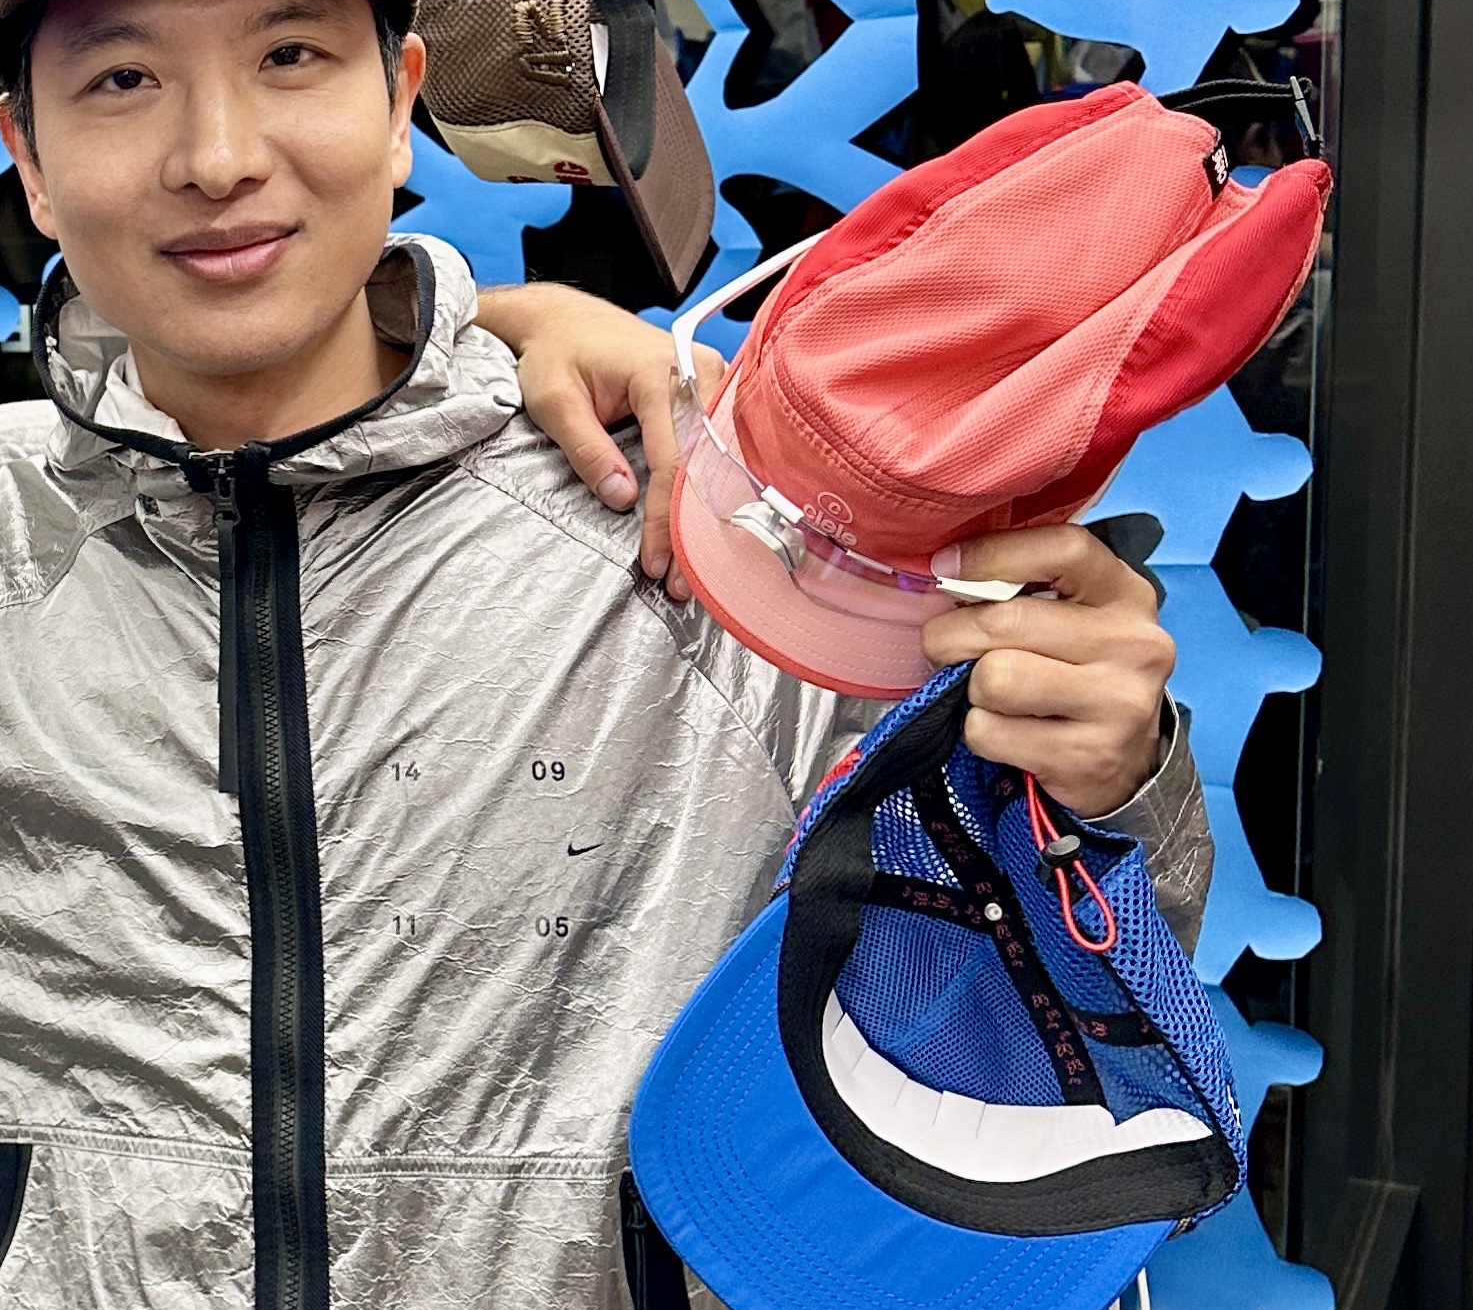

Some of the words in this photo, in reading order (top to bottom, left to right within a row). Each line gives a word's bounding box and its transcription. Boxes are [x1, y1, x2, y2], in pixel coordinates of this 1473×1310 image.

[802, 502, 859, 547] ciele
[390, 762, 422, 782] 14
[531, 760, 566, 782] 09
[391, 915, 418, 936] 11
[535, 916, 570, 938] 05
